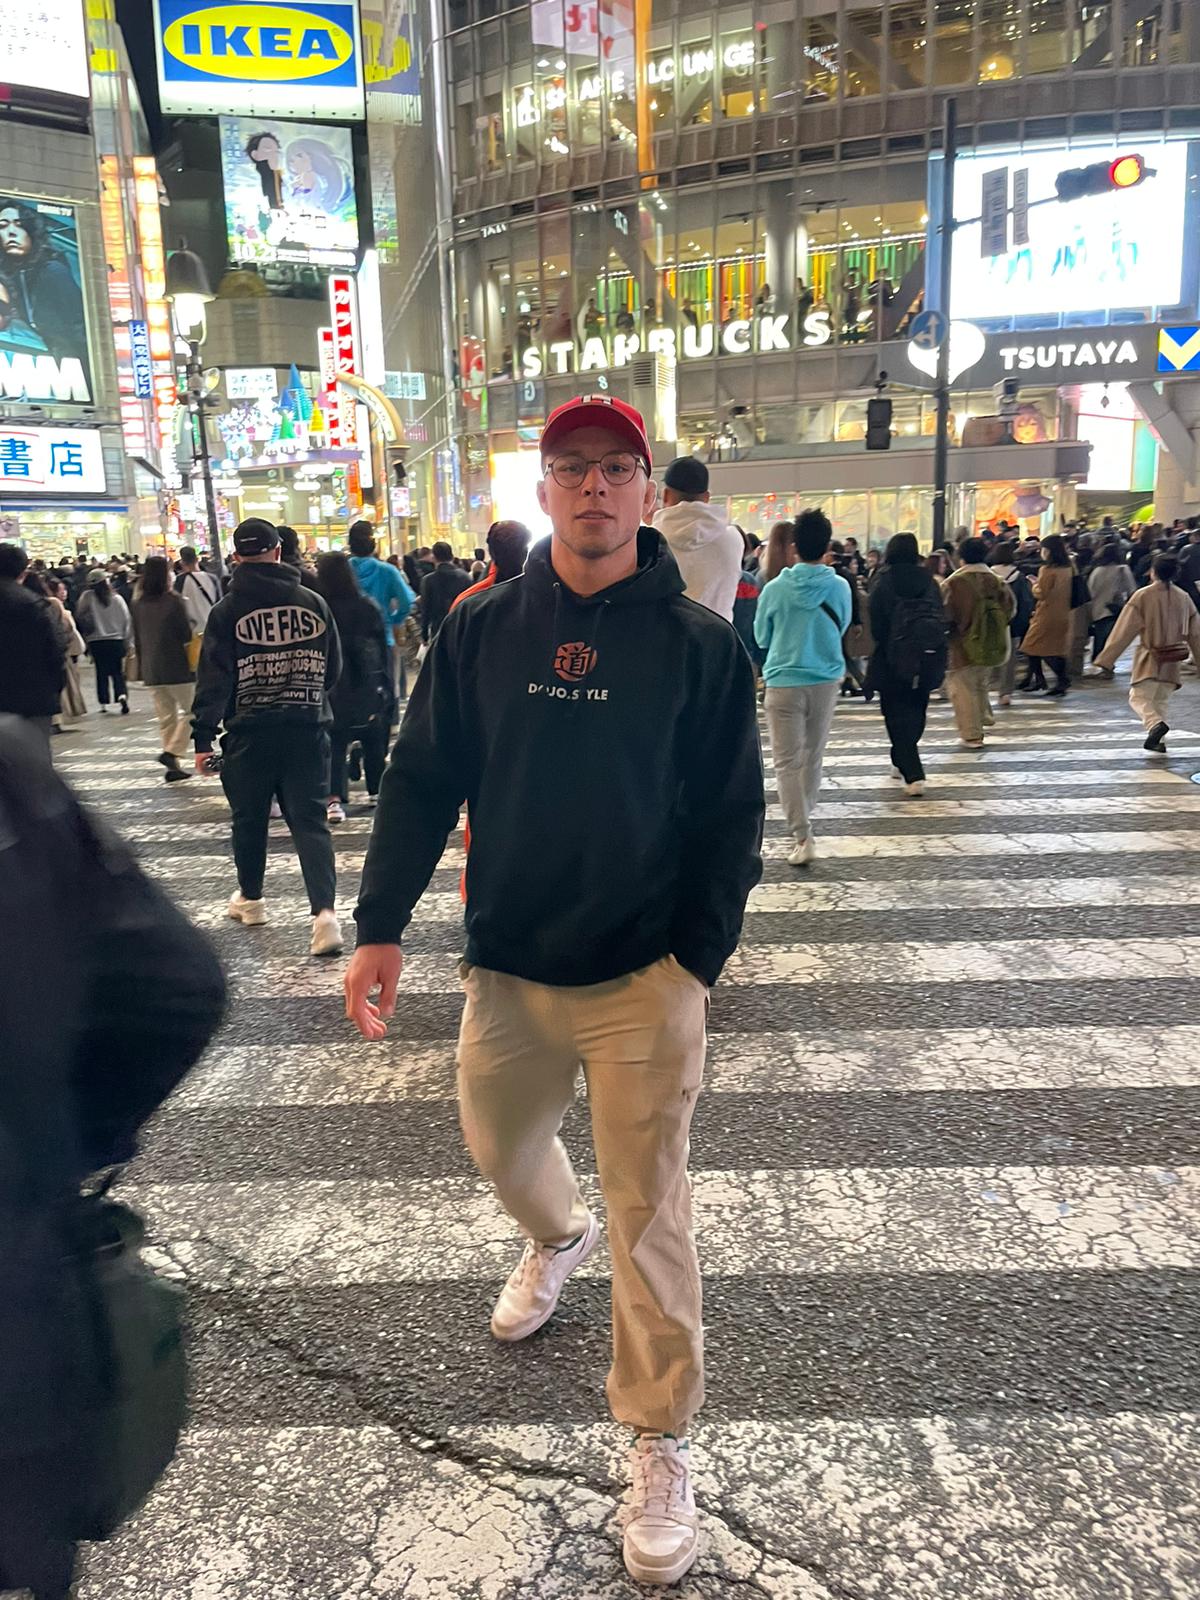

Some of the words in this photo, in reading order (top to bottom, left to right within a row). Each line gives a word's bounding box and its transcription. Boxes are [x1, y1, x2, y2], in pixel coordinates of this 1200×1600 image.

[182, 24, 341, 60] IKEA
[648, 41, 754, 84] LOUNGE
[523, 312, 831, 378] STARBUCKS
[1000, 340, 1138, 370] TSUTAYA
[0, 438, 84, 477] 書店
[238, 611, 275, 642] LIVE
[278, 608, 320, 642] FAST
[237, 649, 325, 668] INTERNATIONAL
